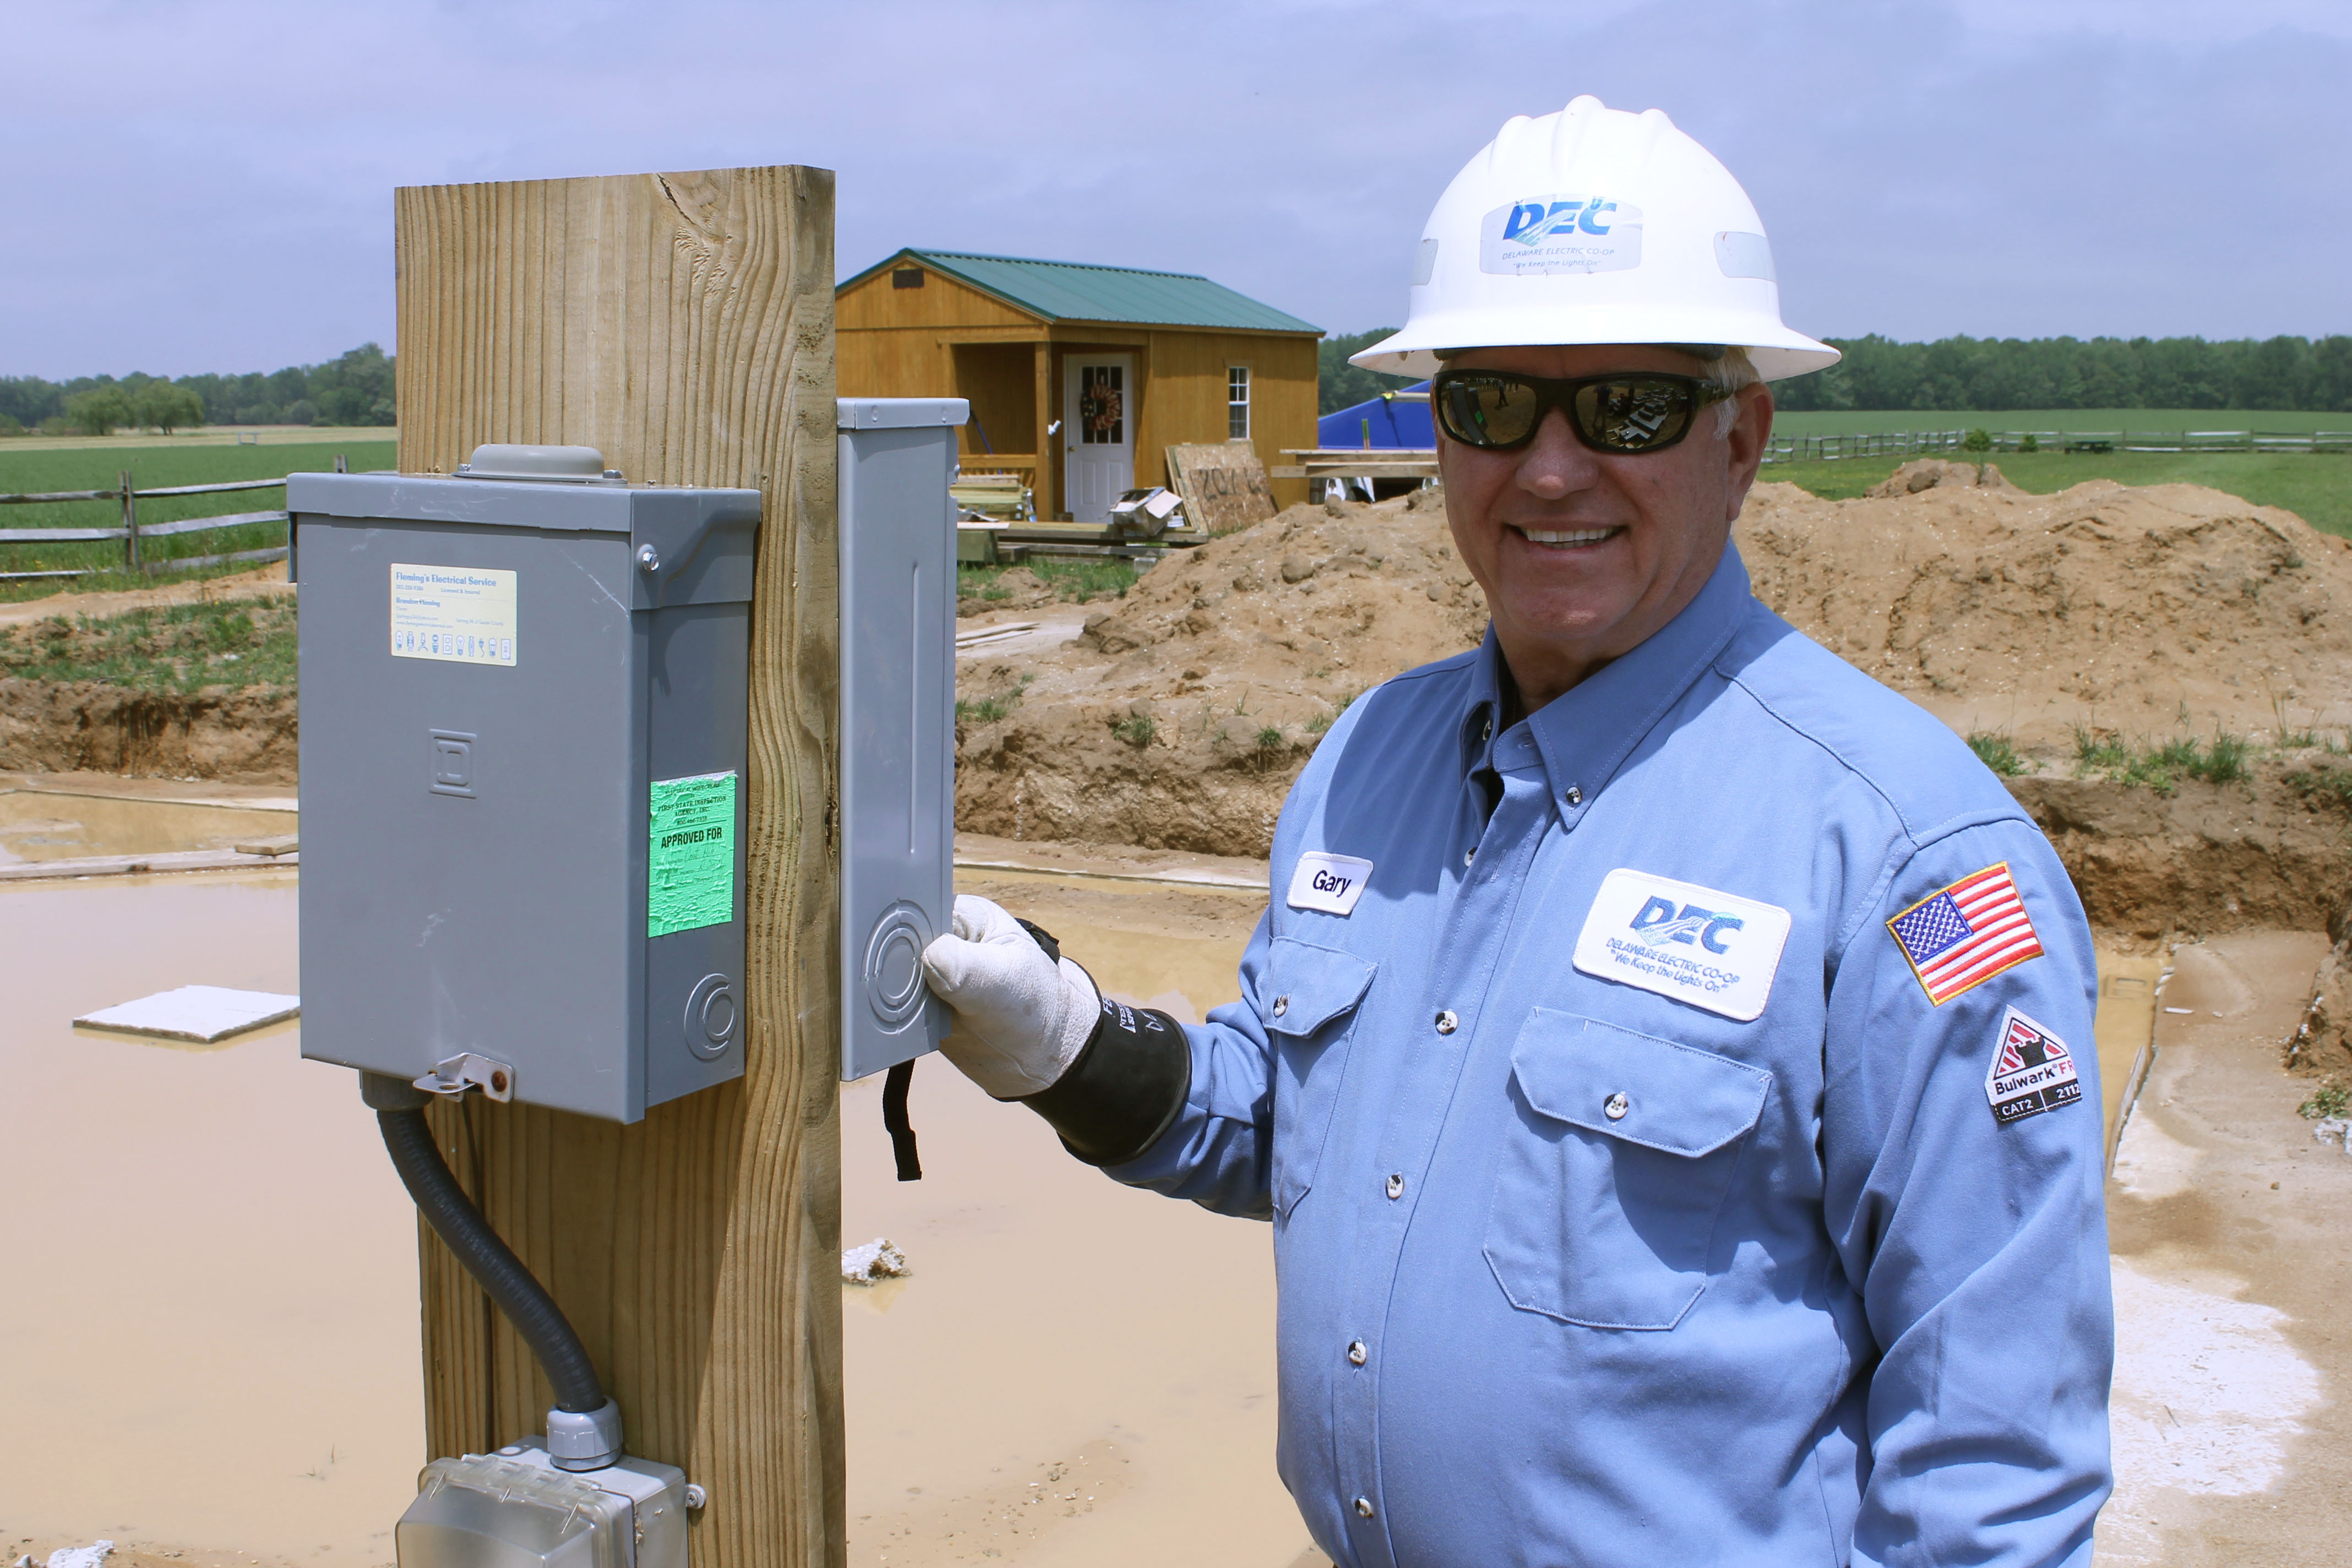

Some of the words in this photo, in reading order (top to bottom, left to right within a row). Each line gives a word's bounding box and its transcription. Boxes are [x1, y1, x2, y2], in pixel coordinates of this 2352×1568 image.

[1502, 199, 1617, 240] DEC
[1502, 248, 1543, 260] DELAWARE
[396, 572, 429, 584] Fleming's
[432, 574, 466, 584] Electrical
[468, 576, 497, 586] Service
[658, 803, 674, 812] FIRST
[676, 800, 694, 810] STATE
[694, 796, 726, 806] INSPECTION
[661, 830, 704, 848] APPROVED
[707, 827, 722, 840] FOR
[1313, 870, 1352, 897] Gary
[1630, 895, 1746, 955] DEC
[1606, 938, 1658, 960] DELAWARE
[1657, 952, 1703, 973] ELECTRIC
[1702, 966, 1741, 984] CO-OP
[1630, 957, 1655, 973] Keep
[1656, 965, 1673, 978] the
[1673, 969, 1702, 988] Lights
[2058, 1060, 2075, 1074] FR
[2001, 1099, 2034, 1116] CAT2
